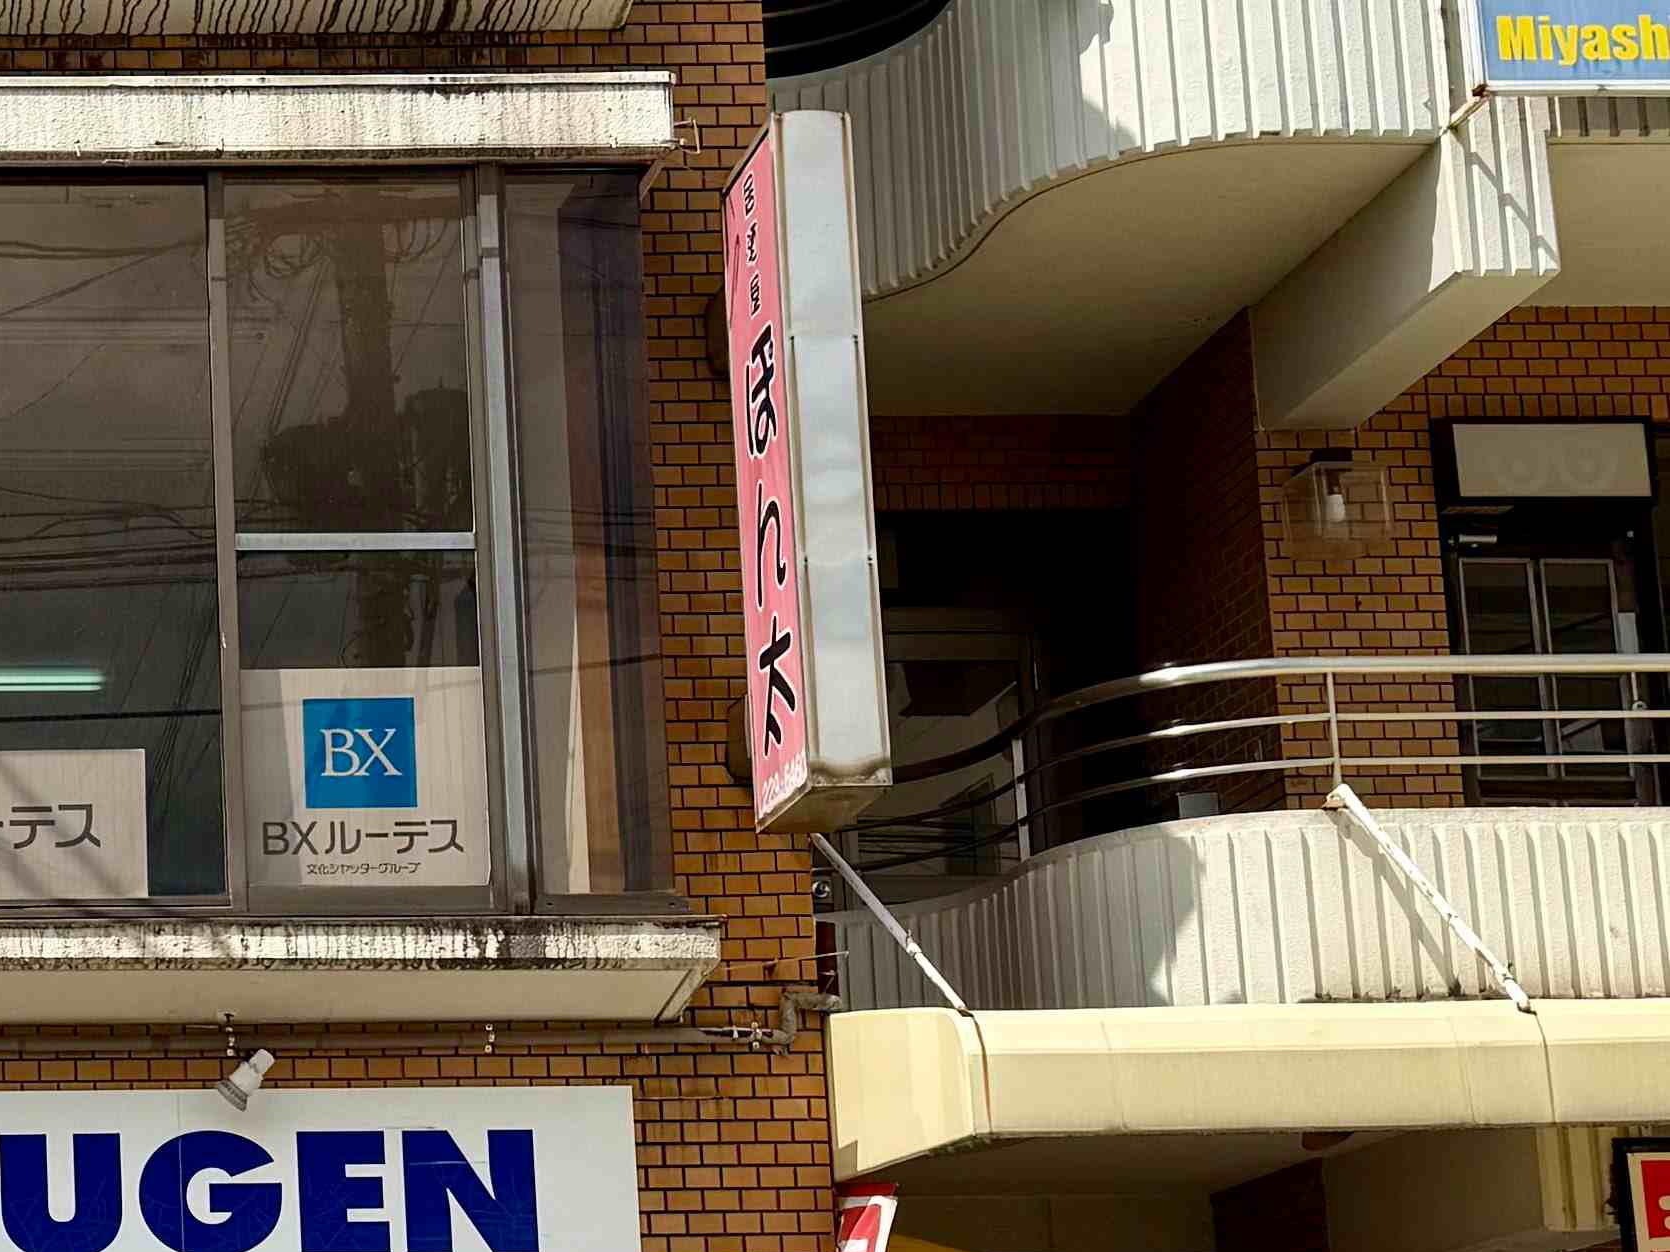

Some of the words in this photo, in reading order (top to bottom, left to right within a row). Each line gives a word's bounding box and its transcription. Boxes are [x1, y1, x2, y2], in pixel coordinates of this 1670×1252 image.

[1496, 15, 1670, 67] Miyash
[320, 728, 403, 777] BX
[262, 819, 464, 856] BXルーテス
